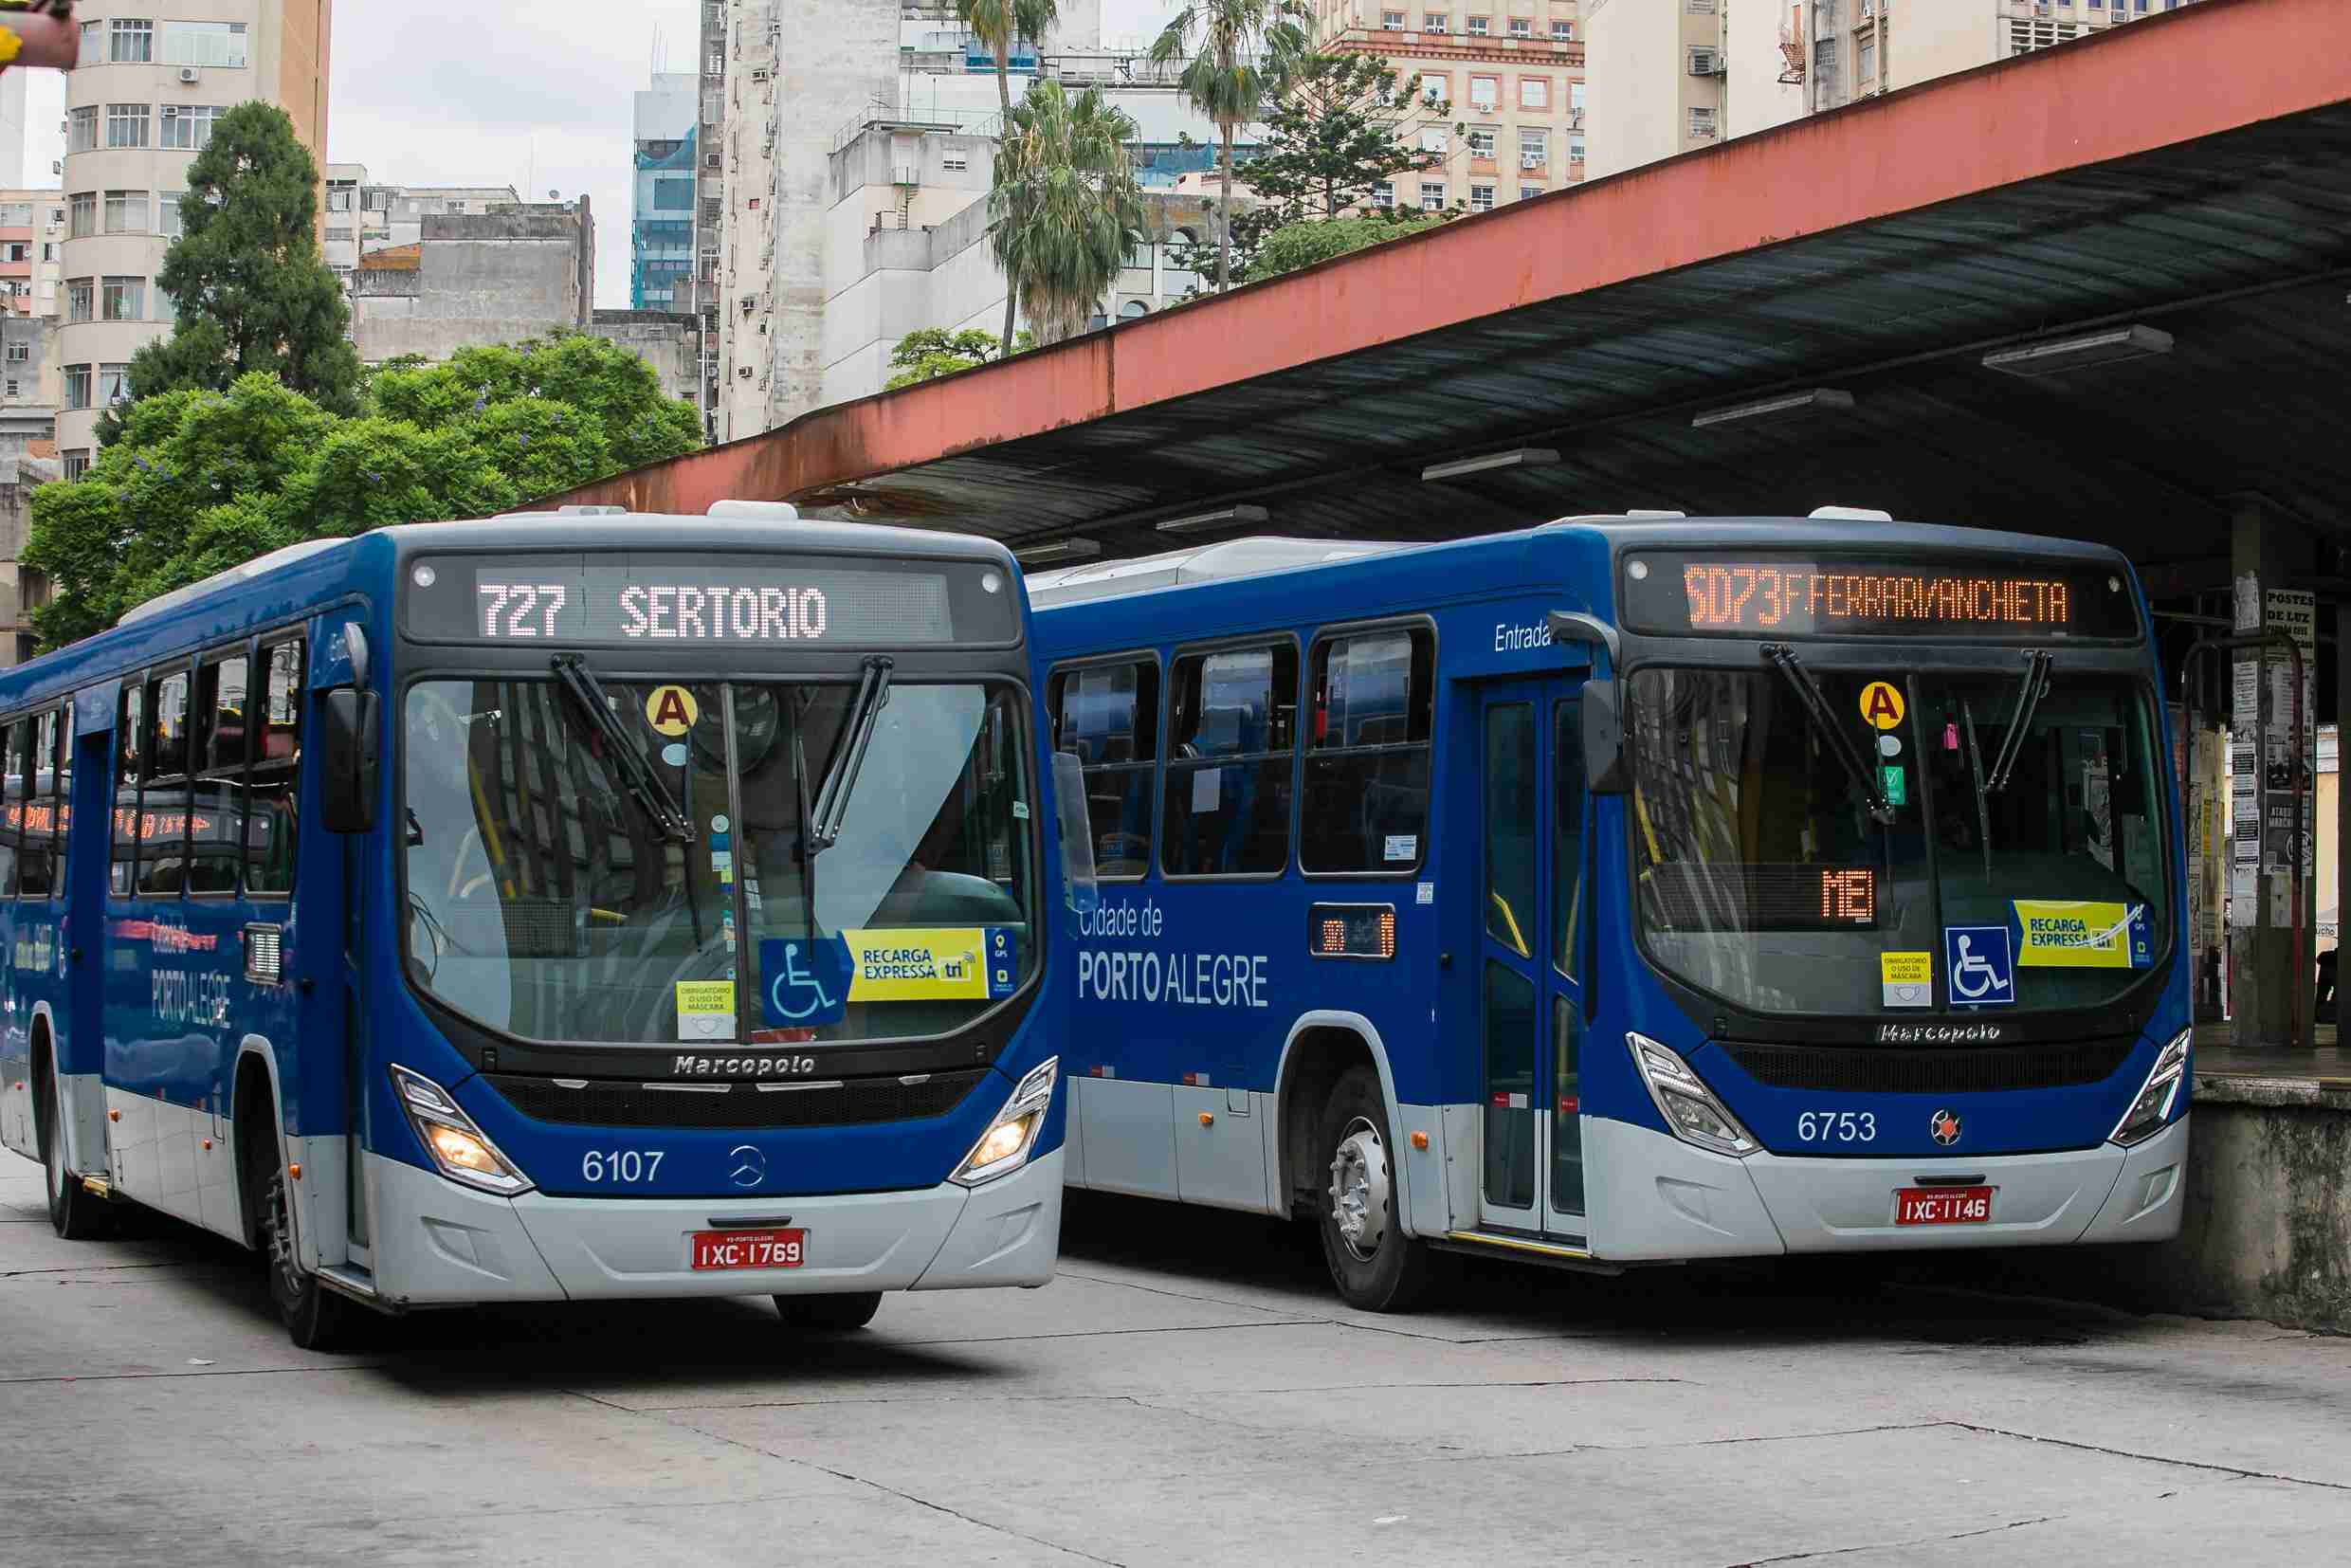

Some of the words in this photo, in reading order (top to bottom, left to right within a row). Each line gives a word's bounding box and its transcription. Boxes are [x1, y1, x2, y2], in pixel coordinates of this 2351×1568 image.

[480, 584, 566, 637] 727
[621, 586, 826, 638] SERTORIO
[2268, 593, 2314, 606] POSTES
[2268, 611, 2284, 621] DE
[2287, 612, 2309, 623] LUZ
[1494, 619, 1551, 651] Entrada
[655, 689, 689, 725] A
[1868, 685, 1899, 720] A
[1080, 897, 1137, 937] Cidade
[1141, 895, 1162, 937] de
[2031, 919, 2086, 932] RECARGA
[864, 949, 932, 963] RECARGA
[865, 965, 937, 979] EXPRESSA
[945, 961, 962, 977] tri
[1079, 952, 1160, 1002] PORTO
[1165, 954, 1268, 1007] ALEGRE
[153, 970, 187, 1022] PORTO
[673, 1056, 815, 1075] Marcopolo
[1797, 1112, 1876, 1141] 6753
[582, 1151, 664, 1182] 6107
